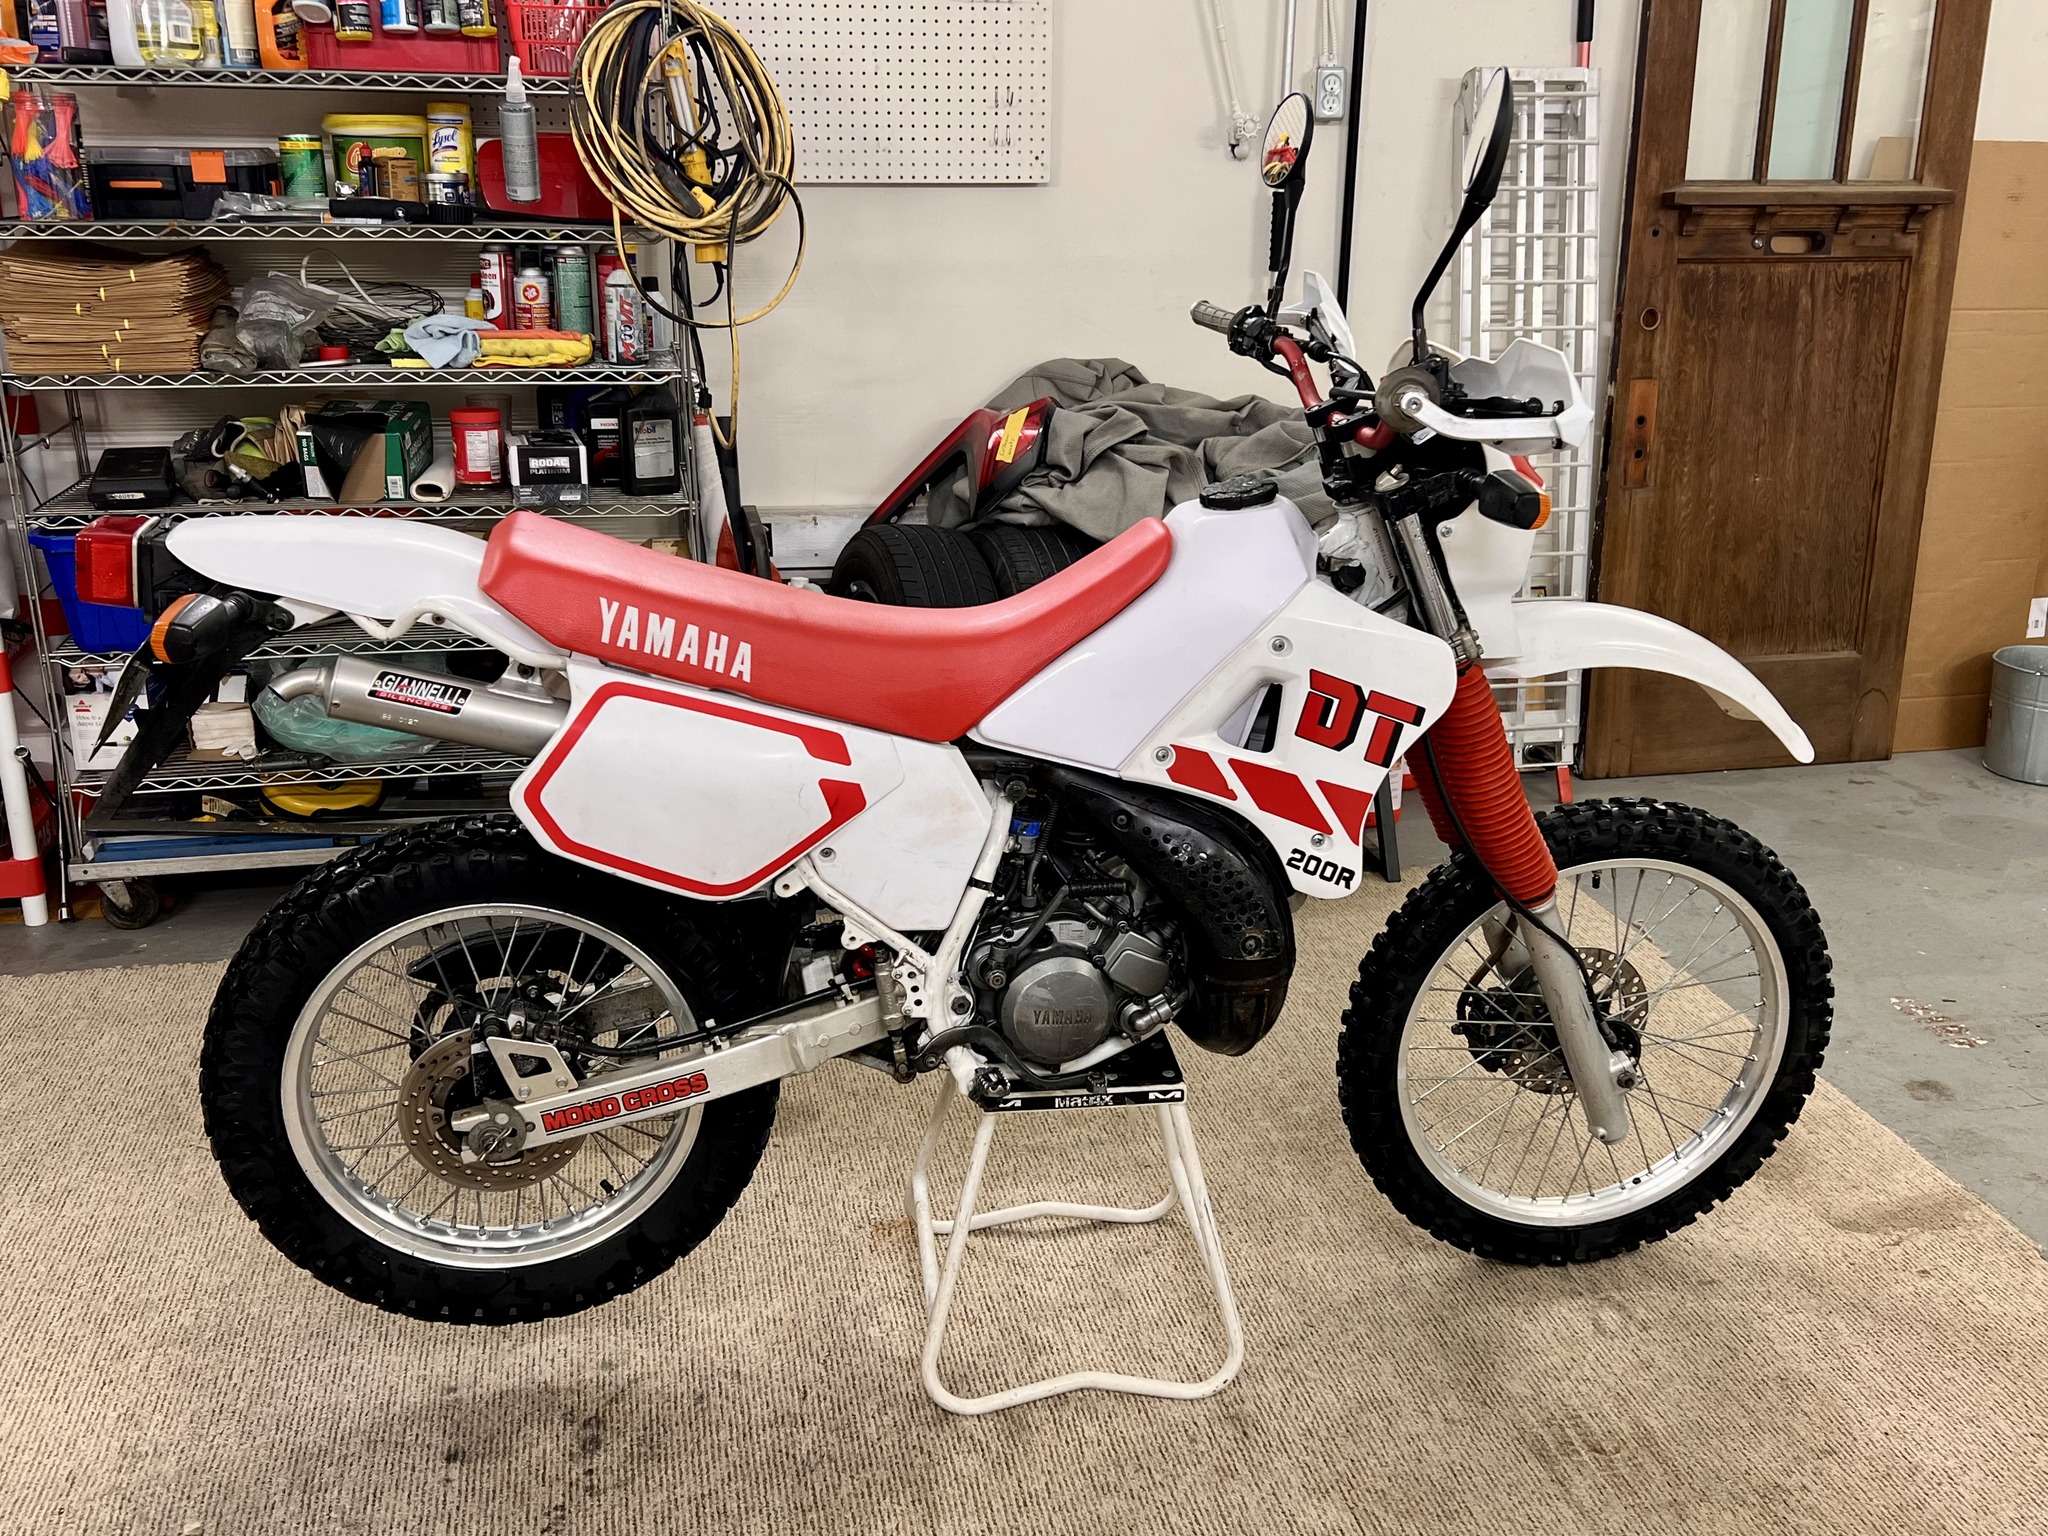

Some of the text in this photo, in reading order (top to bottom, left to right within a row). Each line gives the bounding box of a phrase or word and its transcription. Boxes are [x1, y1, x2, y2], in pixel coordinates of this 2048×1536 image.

[432, 129, 458, 148] Lysol
[481, 271, 497, 280] leen
[635, 425, 656, 435] Mobil
[530, 458, 570, 468] RODAC
[599, 596, 752, 683] YAMAHA
[381, 674, 462, 705] GIANNELLI
[379, 692, 449, 711] SILENCERS
[1294, 668, 1427, 769] DT
[1285, 847, 1356, 891] 200R
[1033, 1009, 1092, 1026] YAMAHA
[540, 1073, 709, 1133] MONO CROSS
[1054, 1094, 1114, 1109] Matrix
